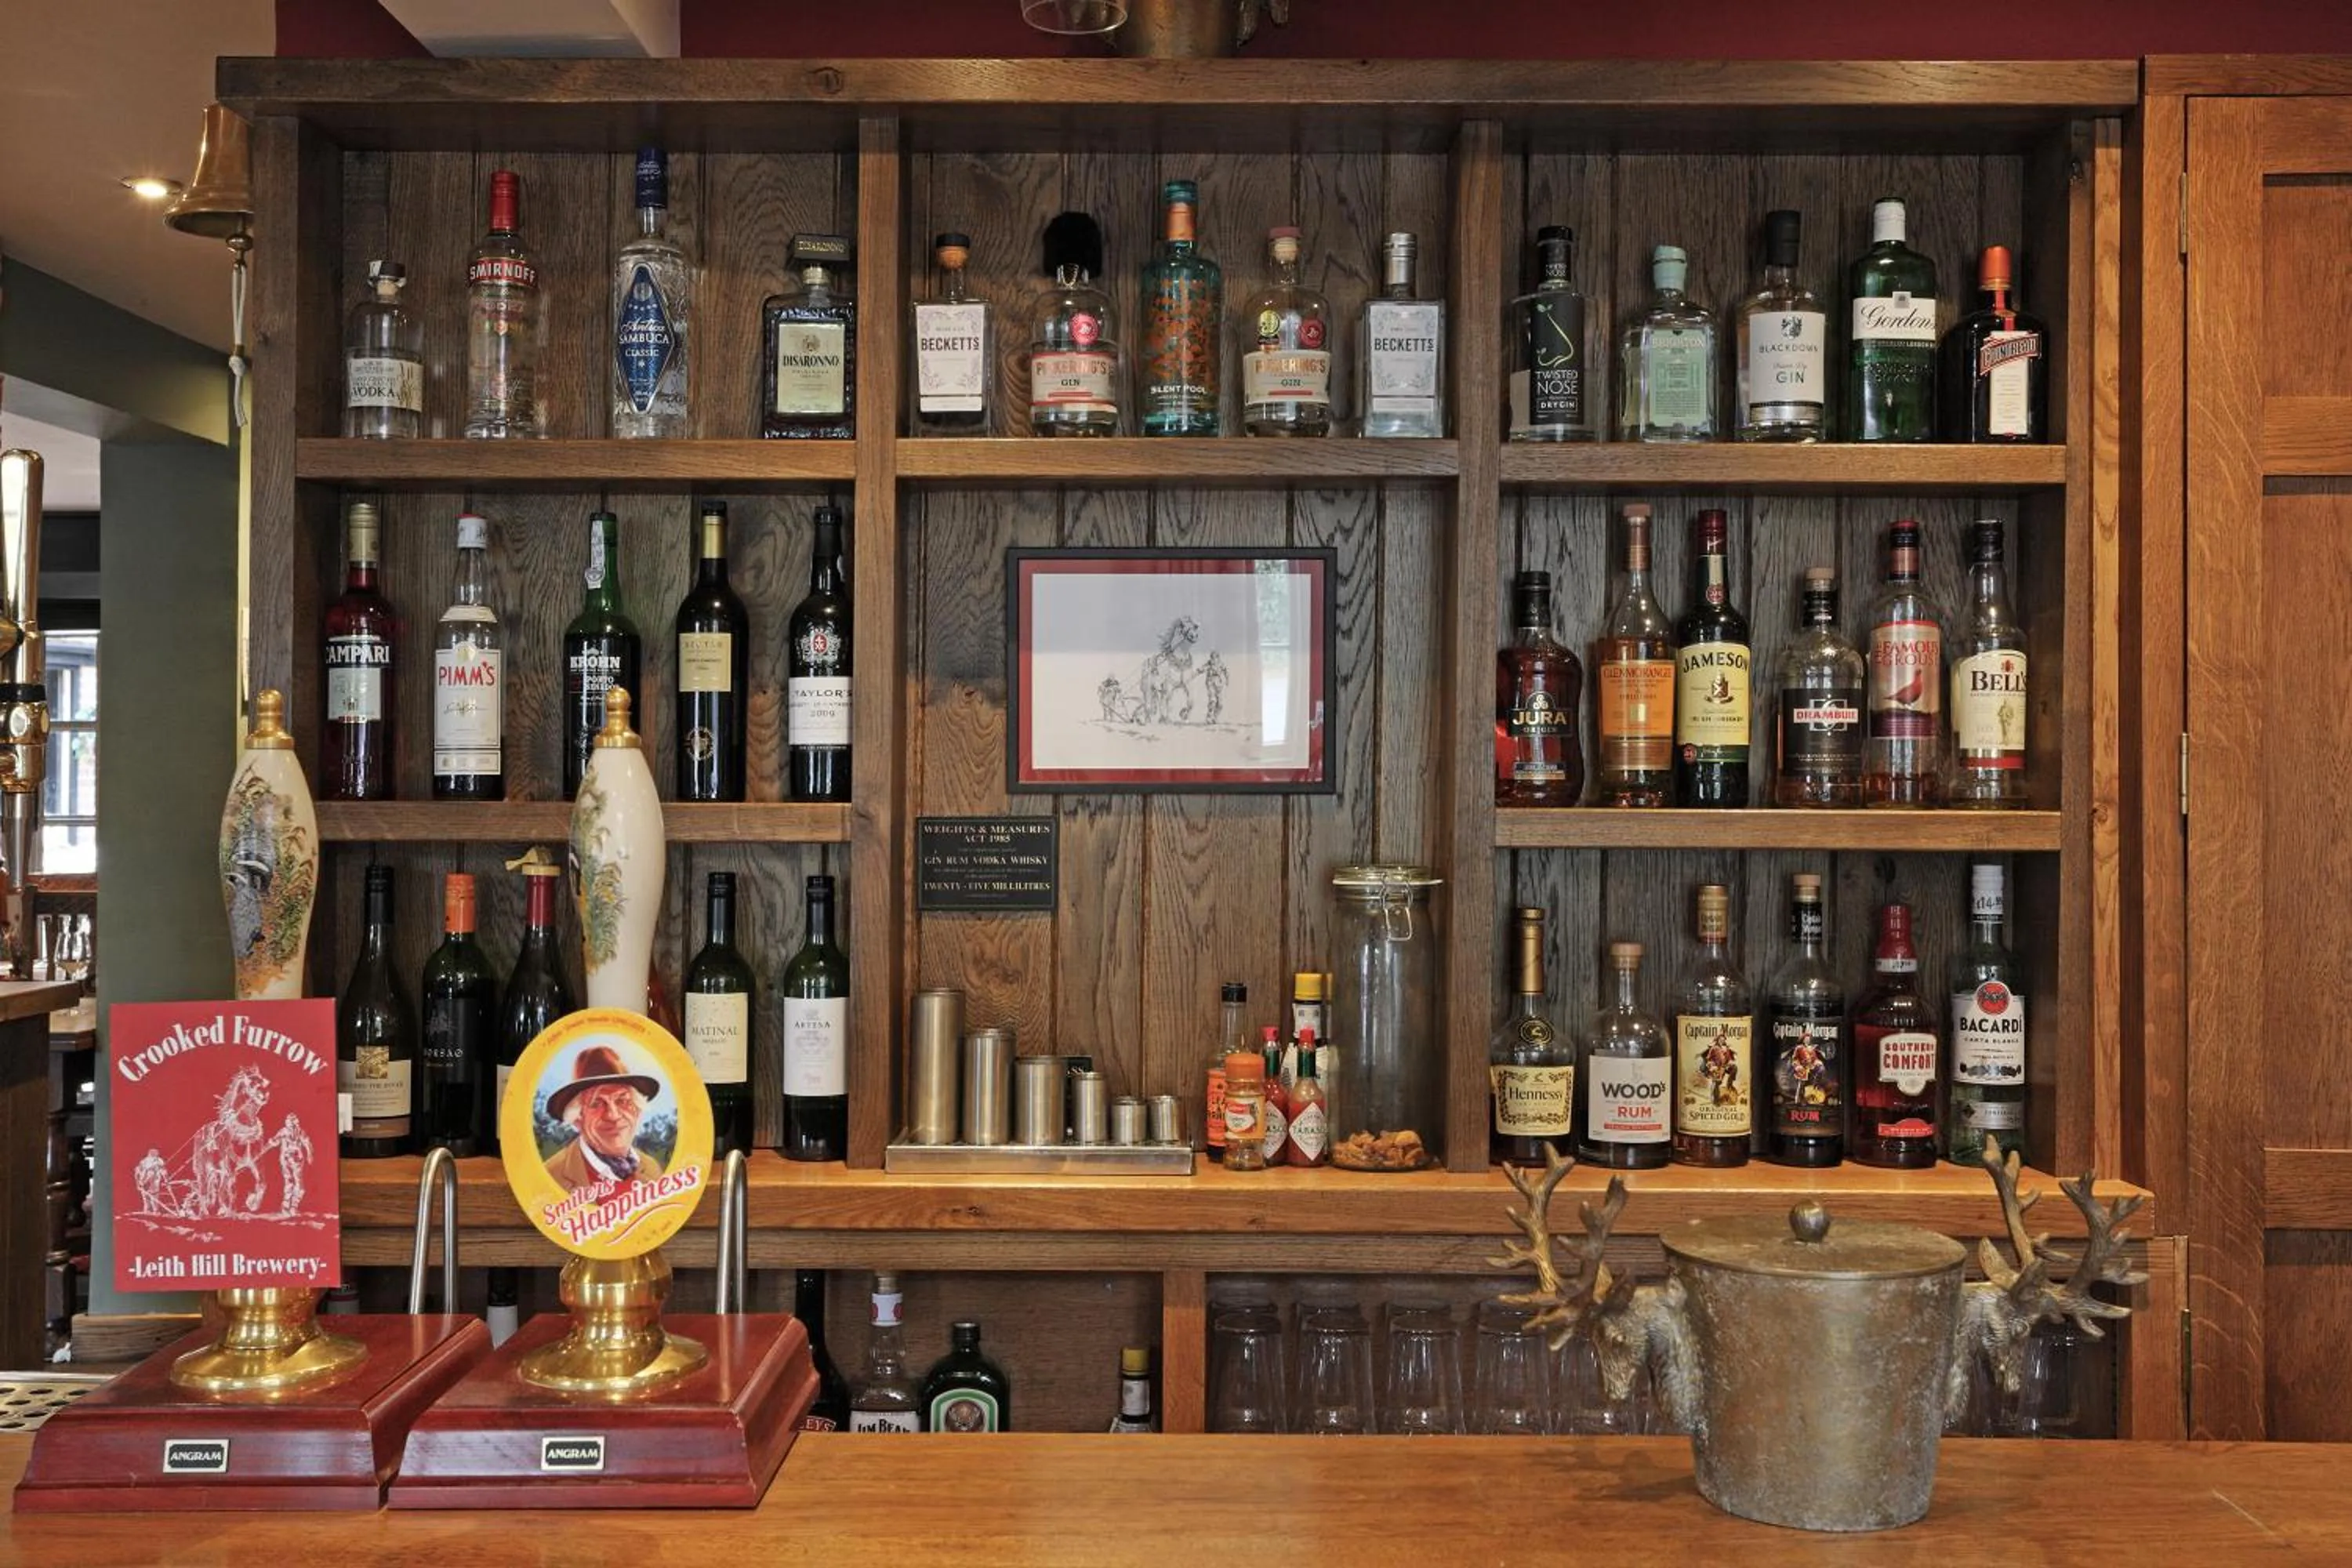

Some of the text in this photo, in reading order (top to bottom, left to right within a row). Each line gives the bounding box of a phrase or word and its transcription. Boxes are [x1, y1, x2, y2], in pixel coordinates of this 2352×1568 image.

[797, 240, 845, 253] DISARONNO
[470, 263, 535, 283] SMIRNOFF
[619, 332, 670, 344] SAMBUCA
[1759, 344, 1820, 354] BLACKDOWN
[783, 354, 840, 368] DISARONNO
[1535, 371, 1578, 380] TWISTED
[1776, 371, 1804, 383] GIN
[353, 387, 395, 397] VODKA
[1150, 383, 1208, 395] SILENT POOL
[1537, 380, 1578, 394] NOSE
[1882, 641, 1939, 654] FAMOUS
[570, 656, 621, 670] KROHN
[1683, 652, 1748, 674] JAMESON
[1882, 653, 1939, 666] GROUSE
[438, 661, 495, 686] PIMM'S
[1603, 667, 1672, 679] GLENMORANGIE
[794, 689, 854, 699] TAYLOR'S
[1512, 711, 1567, 725] JURA
[1796, 710, 1857, 720] DRAMBUIE
[924, 825, 1051, 833] WEIGHTS & MEASURES
[989, 834, 1011, 843] 1985
[924, 855, 1047, 865] GIN RUM VODKA WHISKY
[992, 882, 1051, 891] MILLILITRES
[1685, 1022, 1717, 1040] Captain
[1773, 1022, 1838, 1040] Captain Morgan
[118, 1015, 328, 1082] Crooked Furrow
[1884, 1042, 1934, 1052] SOUTHERN
[1883, 1053, 1934, 1070] COMFORT
[1617, 1106, 1652, 1118] RUM
[1690, 1112, 1722, 1122] SPICED
[1790, 1110, 1820, 1122] RUM
[560, 1166, 699, 1243] Happiness
[191, 1254, 227, 1276] Hill
[858, 1423, 877, 1433] JIM
[170, 1451, 222, 1461] ANGRAM
[547, 1448, 598, 1459] ANGRAM
